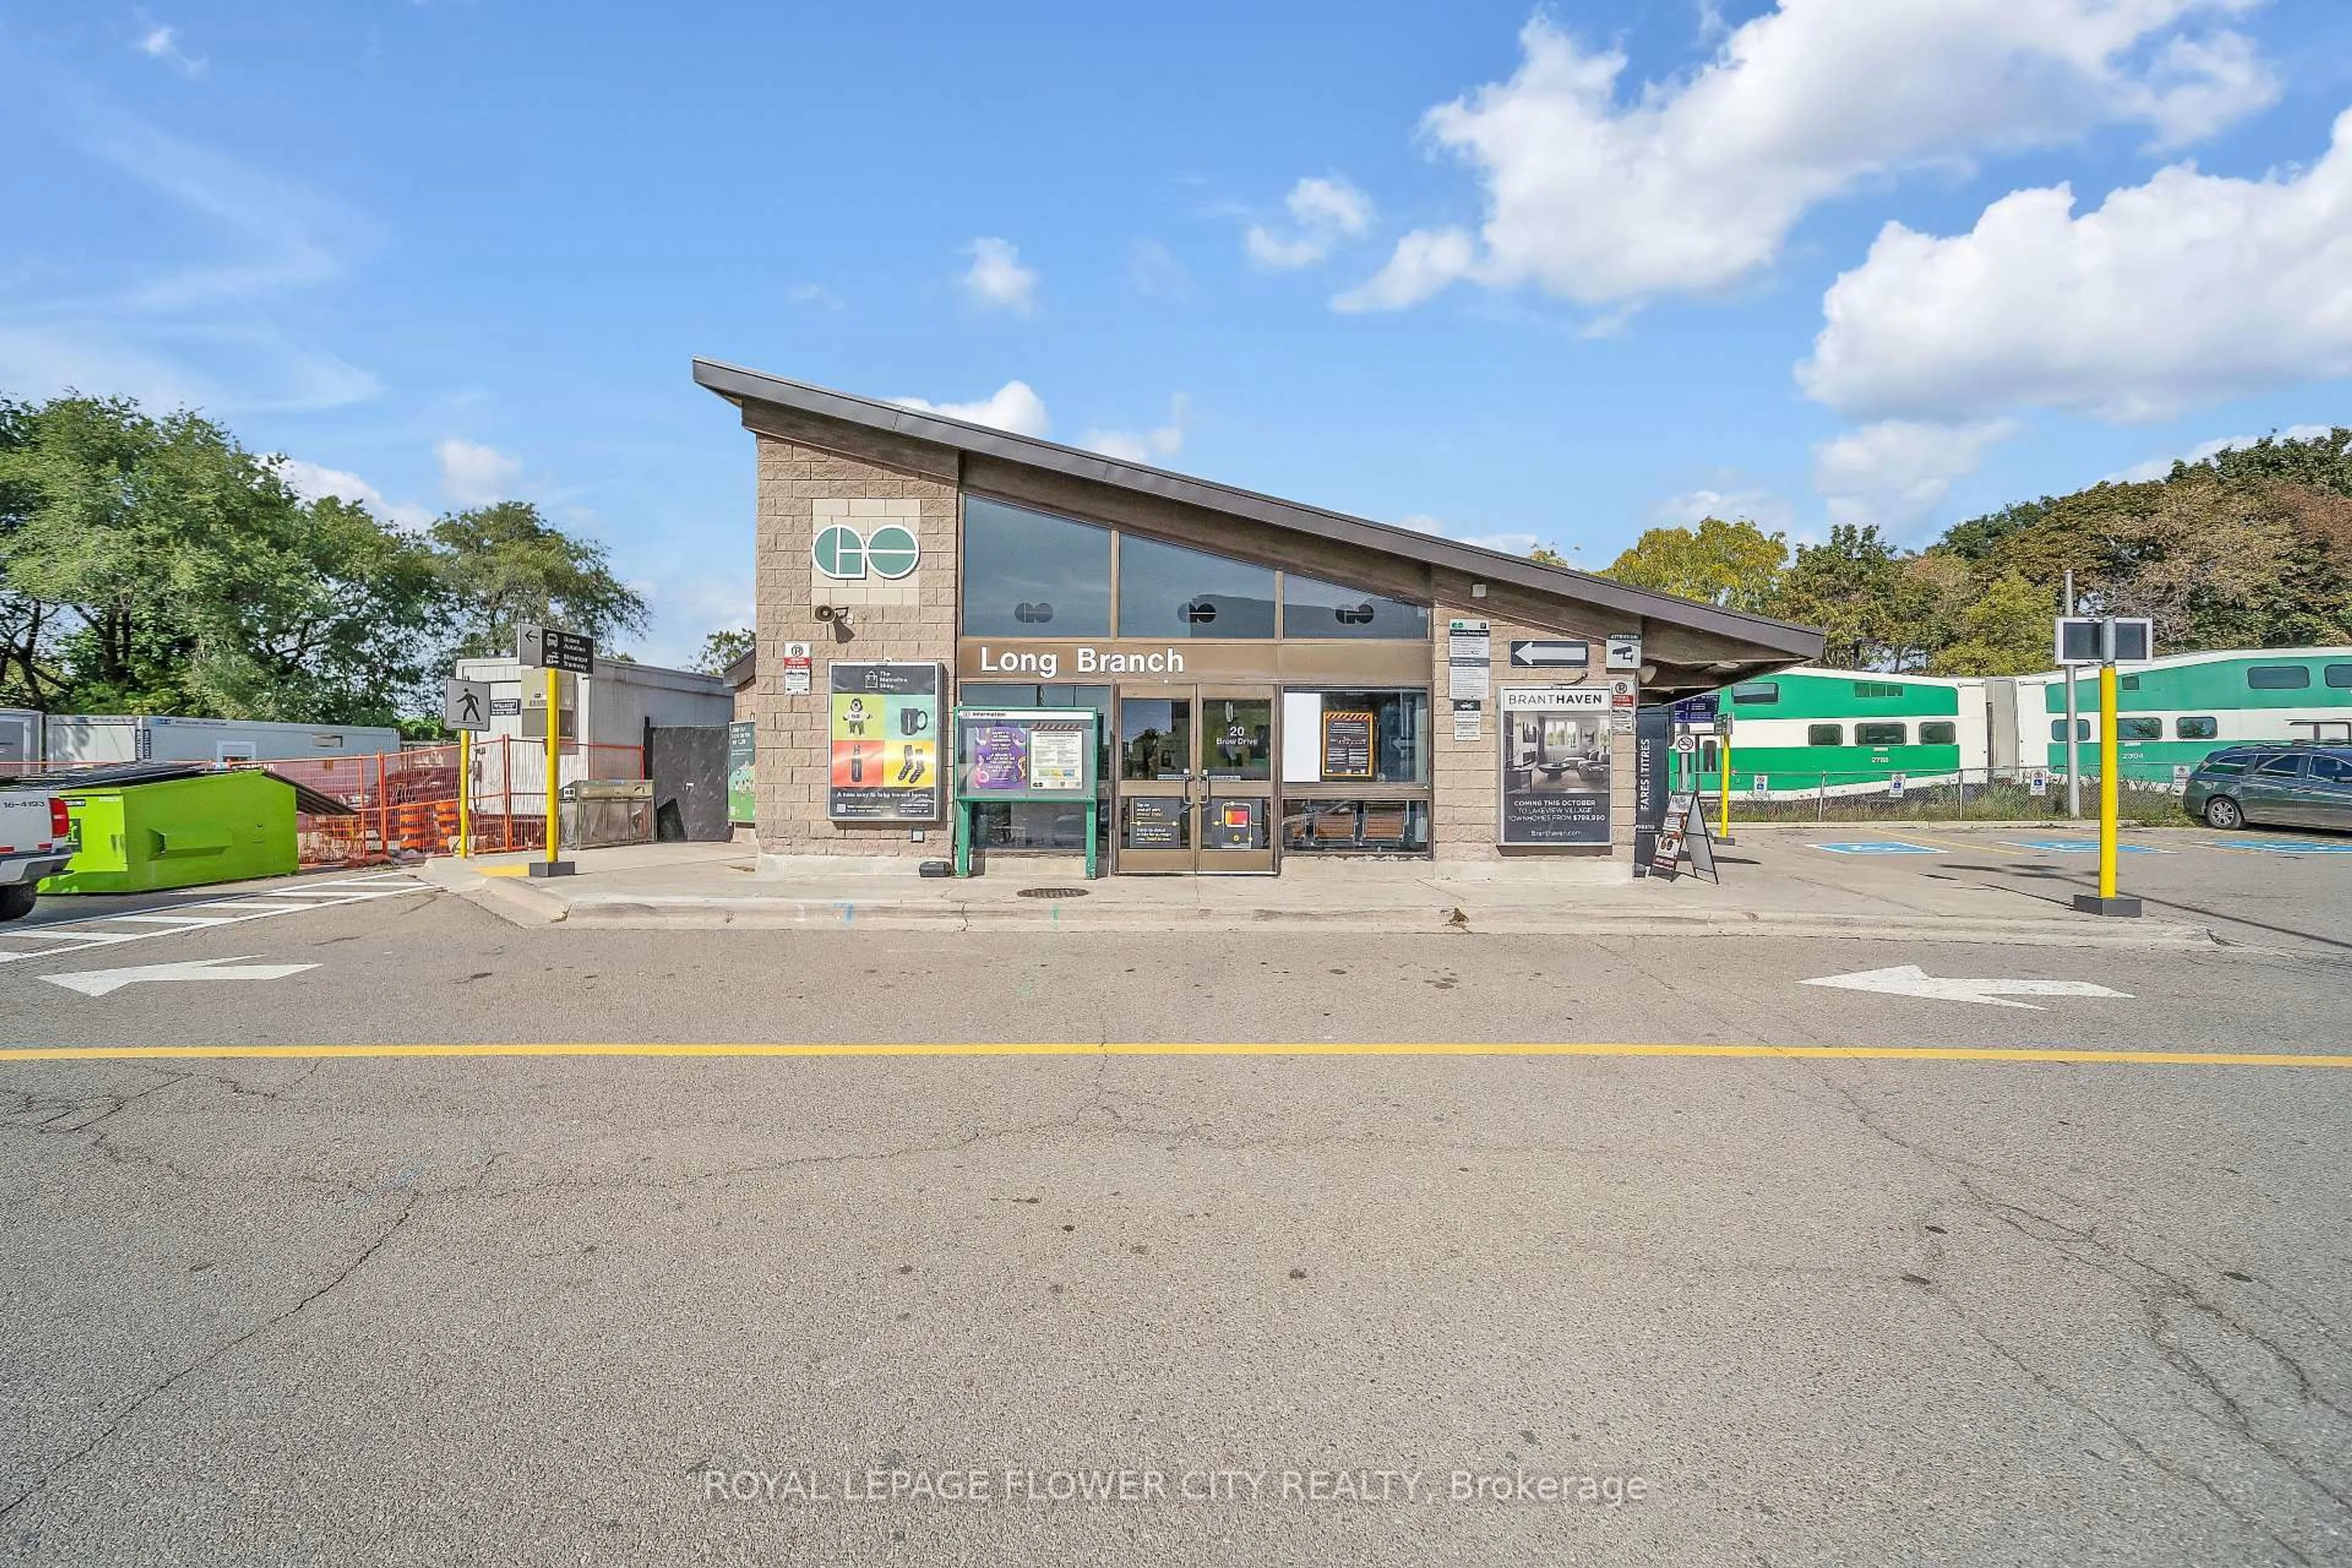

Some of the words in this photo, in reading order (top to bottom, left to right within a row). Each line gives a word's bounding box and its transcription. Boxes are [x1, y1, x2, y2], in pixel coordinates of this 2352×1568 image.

[981, 647, 1058, 678] Long
[1077, 647, 1184, 673] Branch
[1509, 694, 1602, 704] BRANTHAVEN
[1229, 726, 1245, 736] 20
[1640, 739, 1649, 774] TITRES
[1640, 778, 1649, 812] FARES
